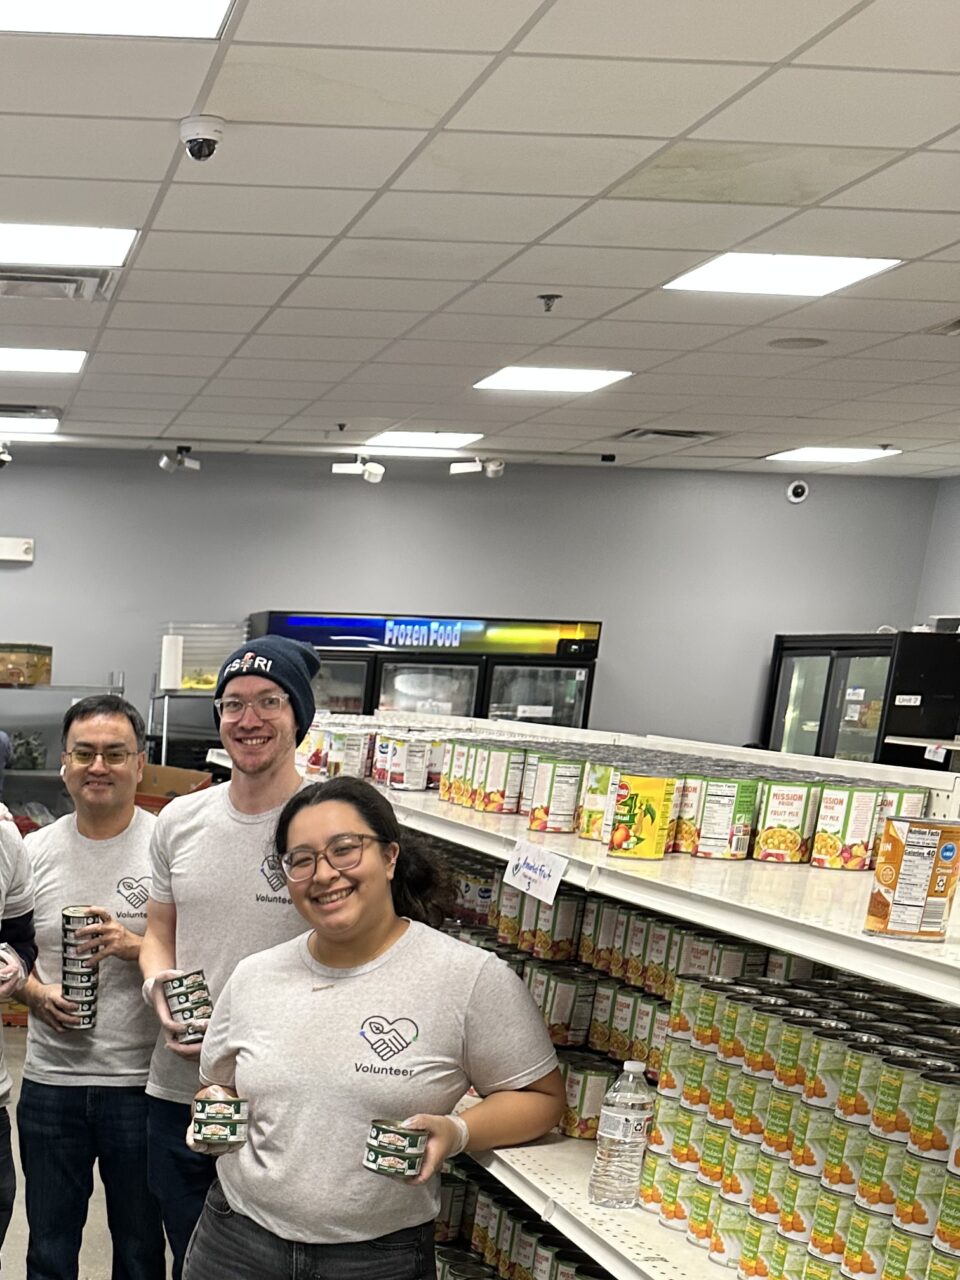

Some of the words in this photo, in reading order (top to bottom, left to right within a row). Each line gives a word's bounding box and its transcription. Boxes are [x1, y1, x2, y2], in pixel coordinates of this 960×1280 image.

[384, 620, 428, 647] Frozen
[429, 621, 462, 647] Food
[772, 792, 804, 802] MISSION
[770, 809, 787, 817] FRUIT
[927, 848, 936, 857] 40
[354, 1062, 416, 1077] Volunteer
